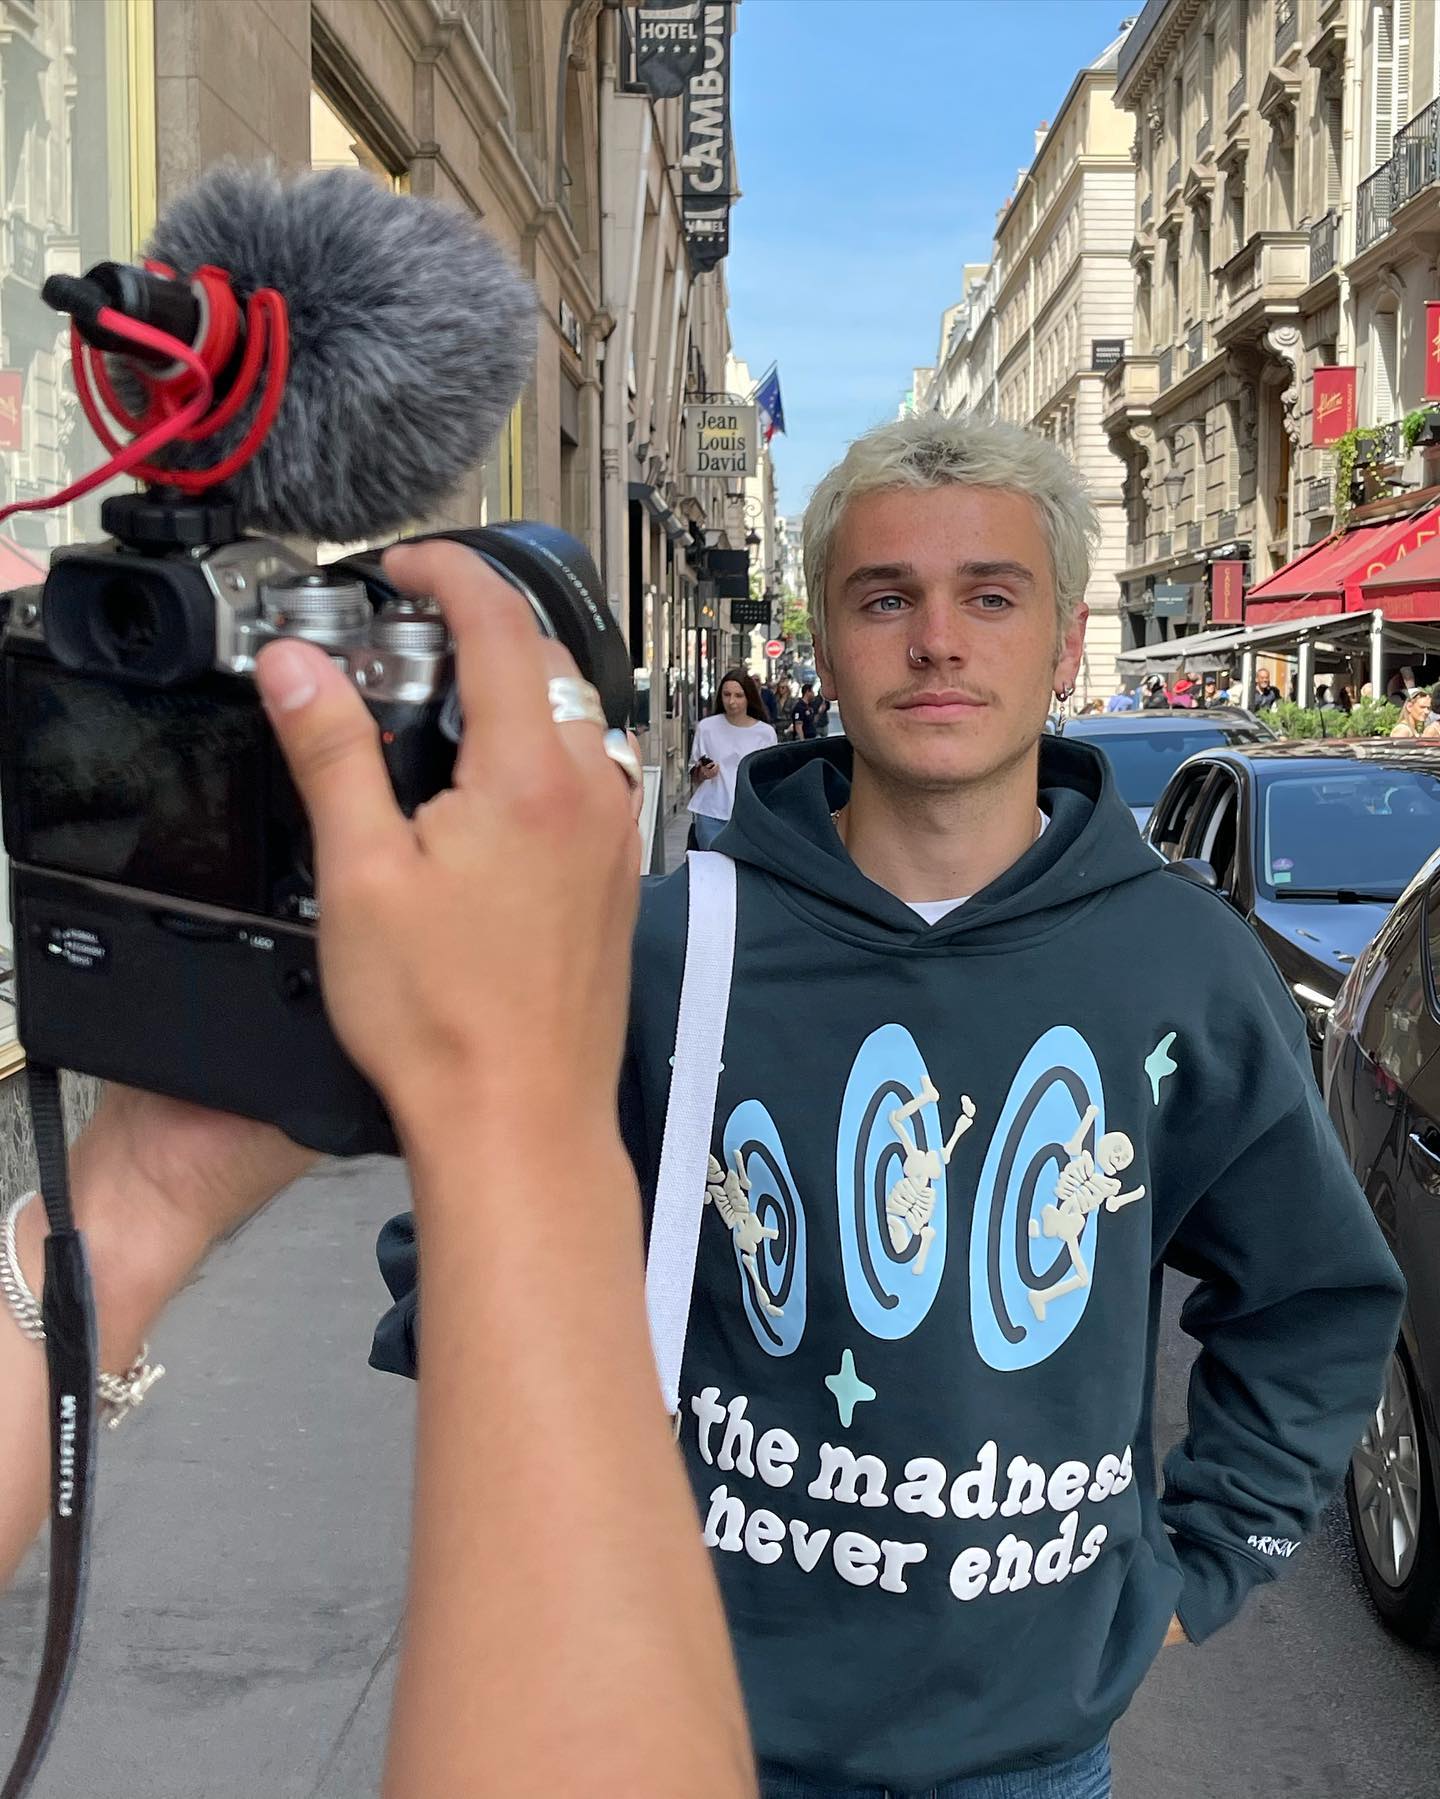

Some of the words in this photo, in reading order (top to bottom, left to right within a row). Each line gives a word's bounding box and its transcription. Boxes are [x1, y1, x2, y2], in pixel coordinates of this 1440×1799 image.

[640, 22, 698, 40] HOTEL
[690, 5, 724, 193] CAMBON
[697, 410, 738, 430] Jean
[697, 431, 746, 451] Louis
[697, 452, 747, 472] David
[59, 1395, 76, 1516] FUJIFILM
[691, 1386, 799, 1488] the
[807, 1440, 1133, 1520] madness
[703, 1484, 927, 1593] never
[949, 1511, 1108, 1601] ends
